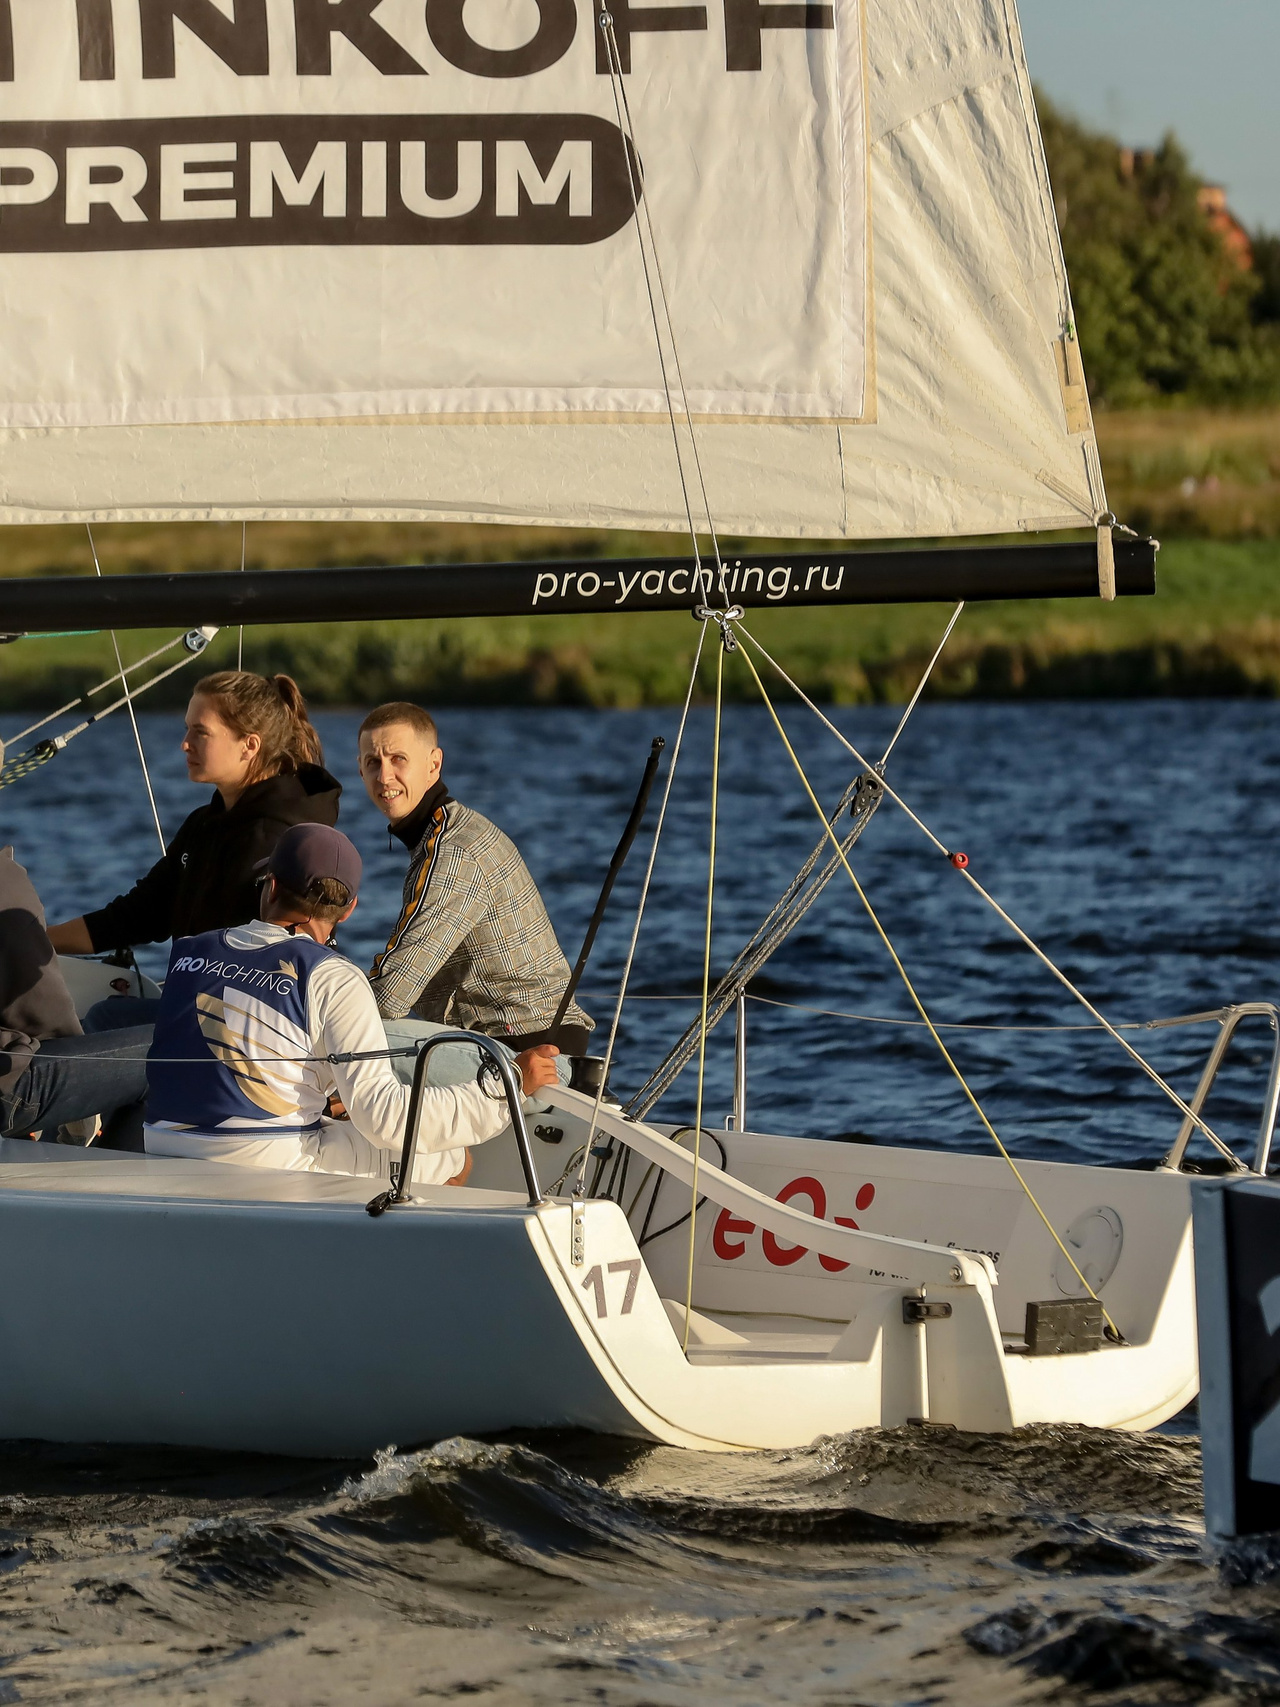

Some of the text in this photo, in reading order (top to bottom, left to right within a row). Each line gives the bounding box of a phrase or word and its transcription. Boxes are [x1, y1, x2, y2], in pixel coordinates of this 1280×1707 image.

[531, 560, 846, 606] pro-yachting.ru
[170, 956, 294, 996] PROYACHTING
[581, 1258, 642, 1318] 17
